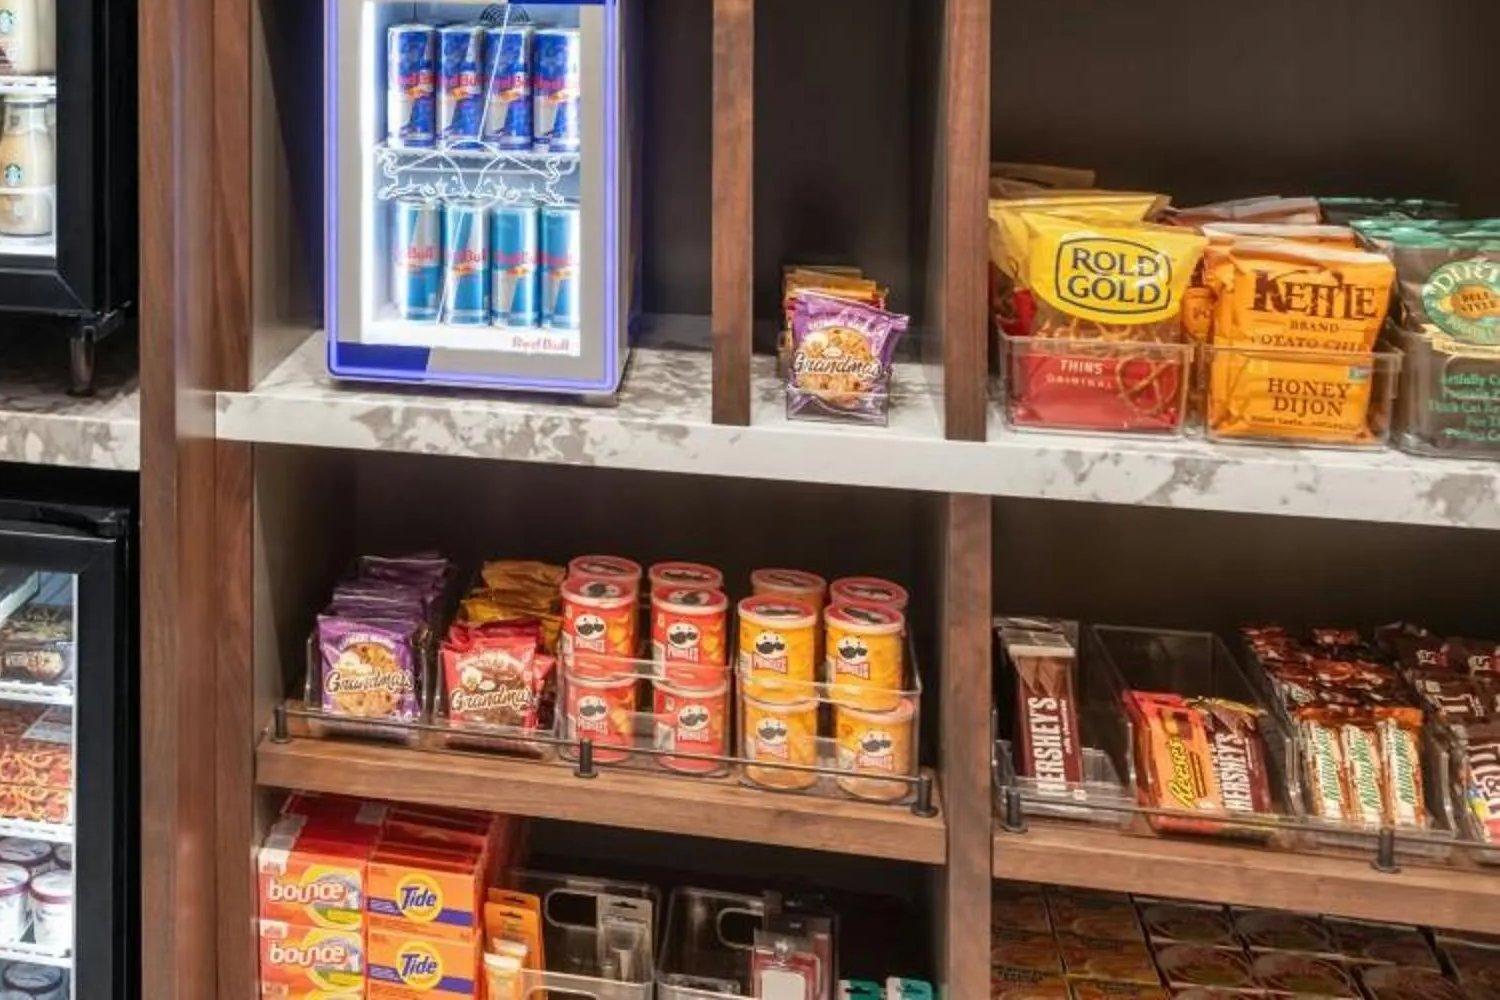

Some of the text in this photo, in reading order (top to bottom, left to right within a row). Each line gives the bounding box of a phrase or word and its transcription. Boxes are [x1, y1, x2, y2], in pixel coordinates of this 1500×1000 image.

[1071, 247, 1160, 277] ROLD
[1067, 275, 1161, 305] GOLD
[1289, 320, 1340, 333] BRAND
[1060, 359, 1104, 375] THINS
[1267, 377, 1351, 400] HONEY
[1272, 396, 1345, 418] DIJON
[1027, 697, 1068, 797] HERSHEY'S
[1214, 731, 1253, 811] HERSHEY'S
[269, 879, 346, 904] bounce
[400, 886, 439, 908] Tide
[269, 944, 348, 968] bounce
[400, 953, 440, 976] Tide
